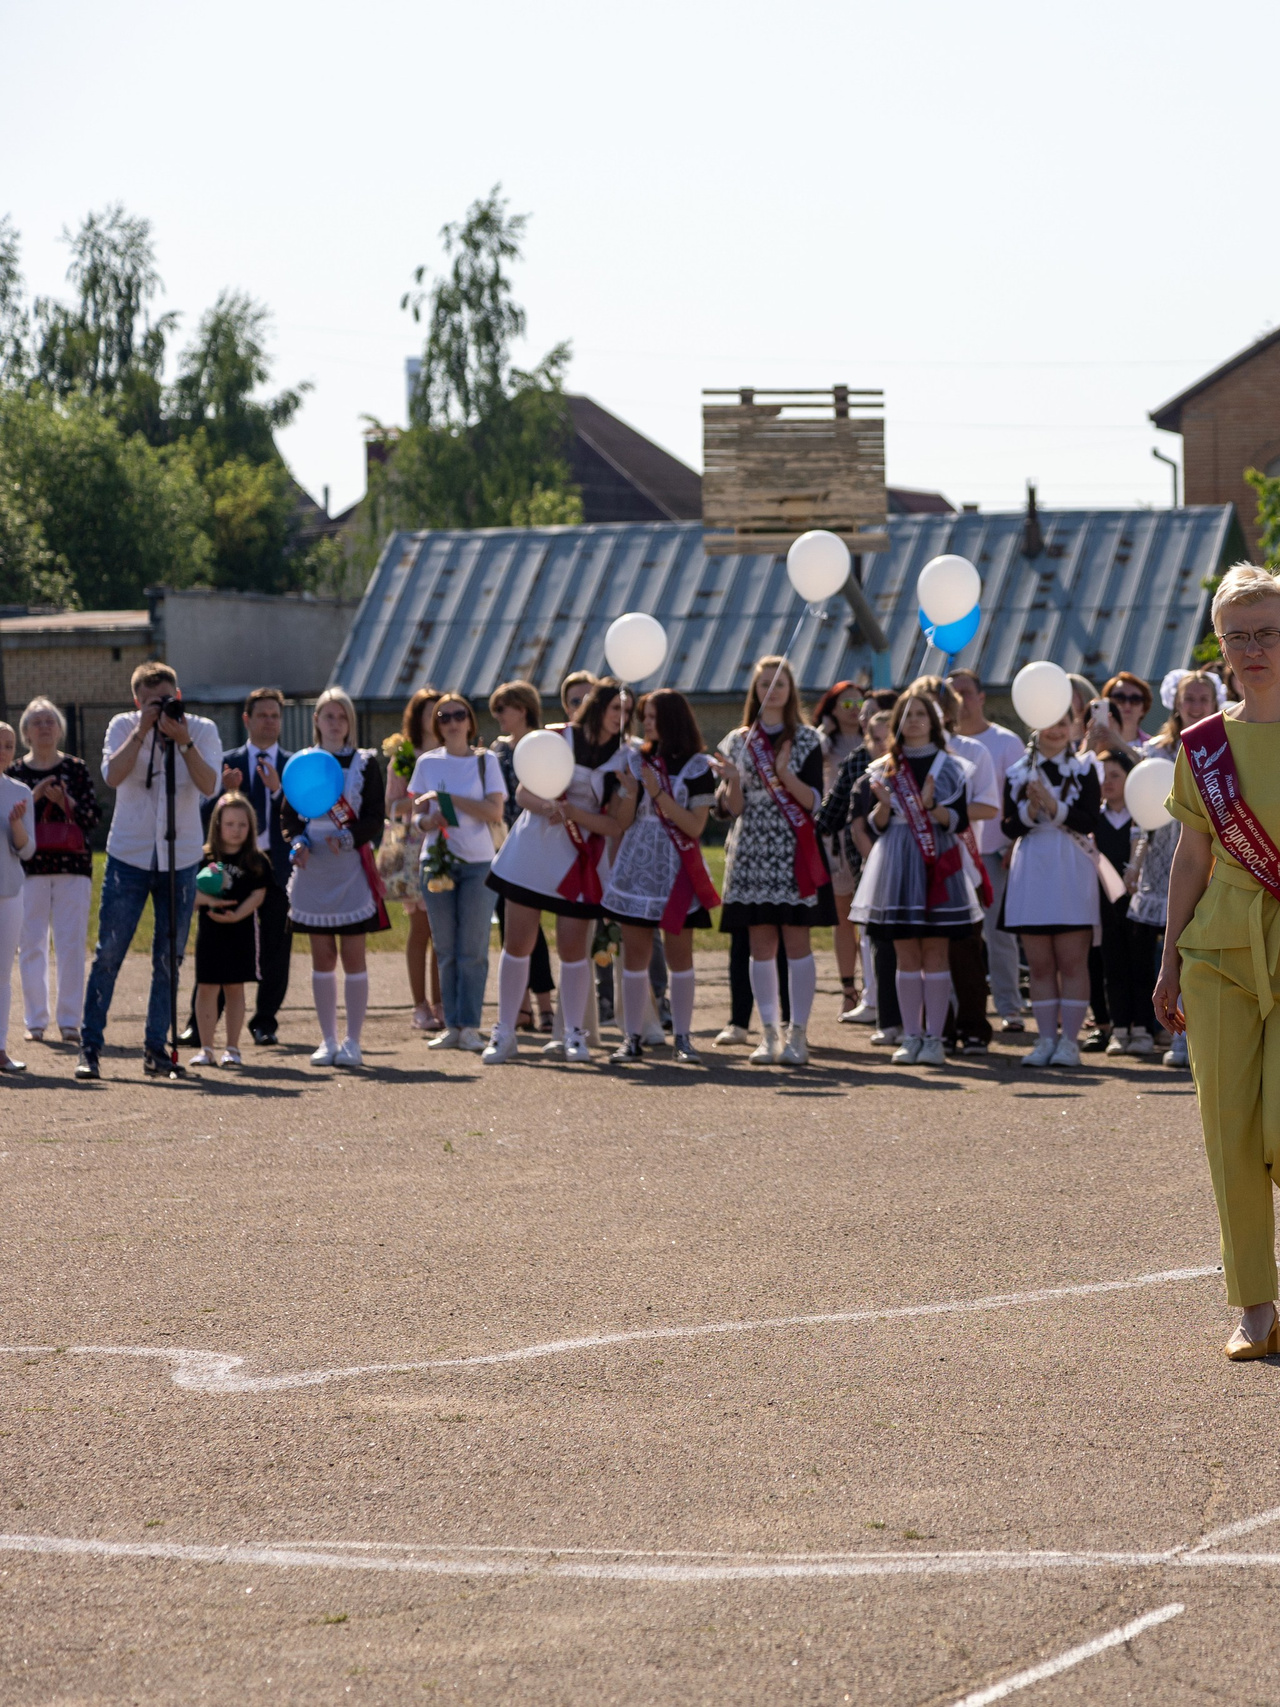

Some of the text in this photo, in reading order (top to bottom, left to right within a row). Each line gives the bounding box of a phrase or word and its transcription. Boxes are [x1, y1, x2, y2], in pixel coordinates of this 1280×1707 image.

[1203, 768, 1235, 827] Классный
[1225, 774, 1235, 798] Жилко
[1232, 799, 1246, 819] Лина
[1244, 817, 1277, 862] Васильевна
